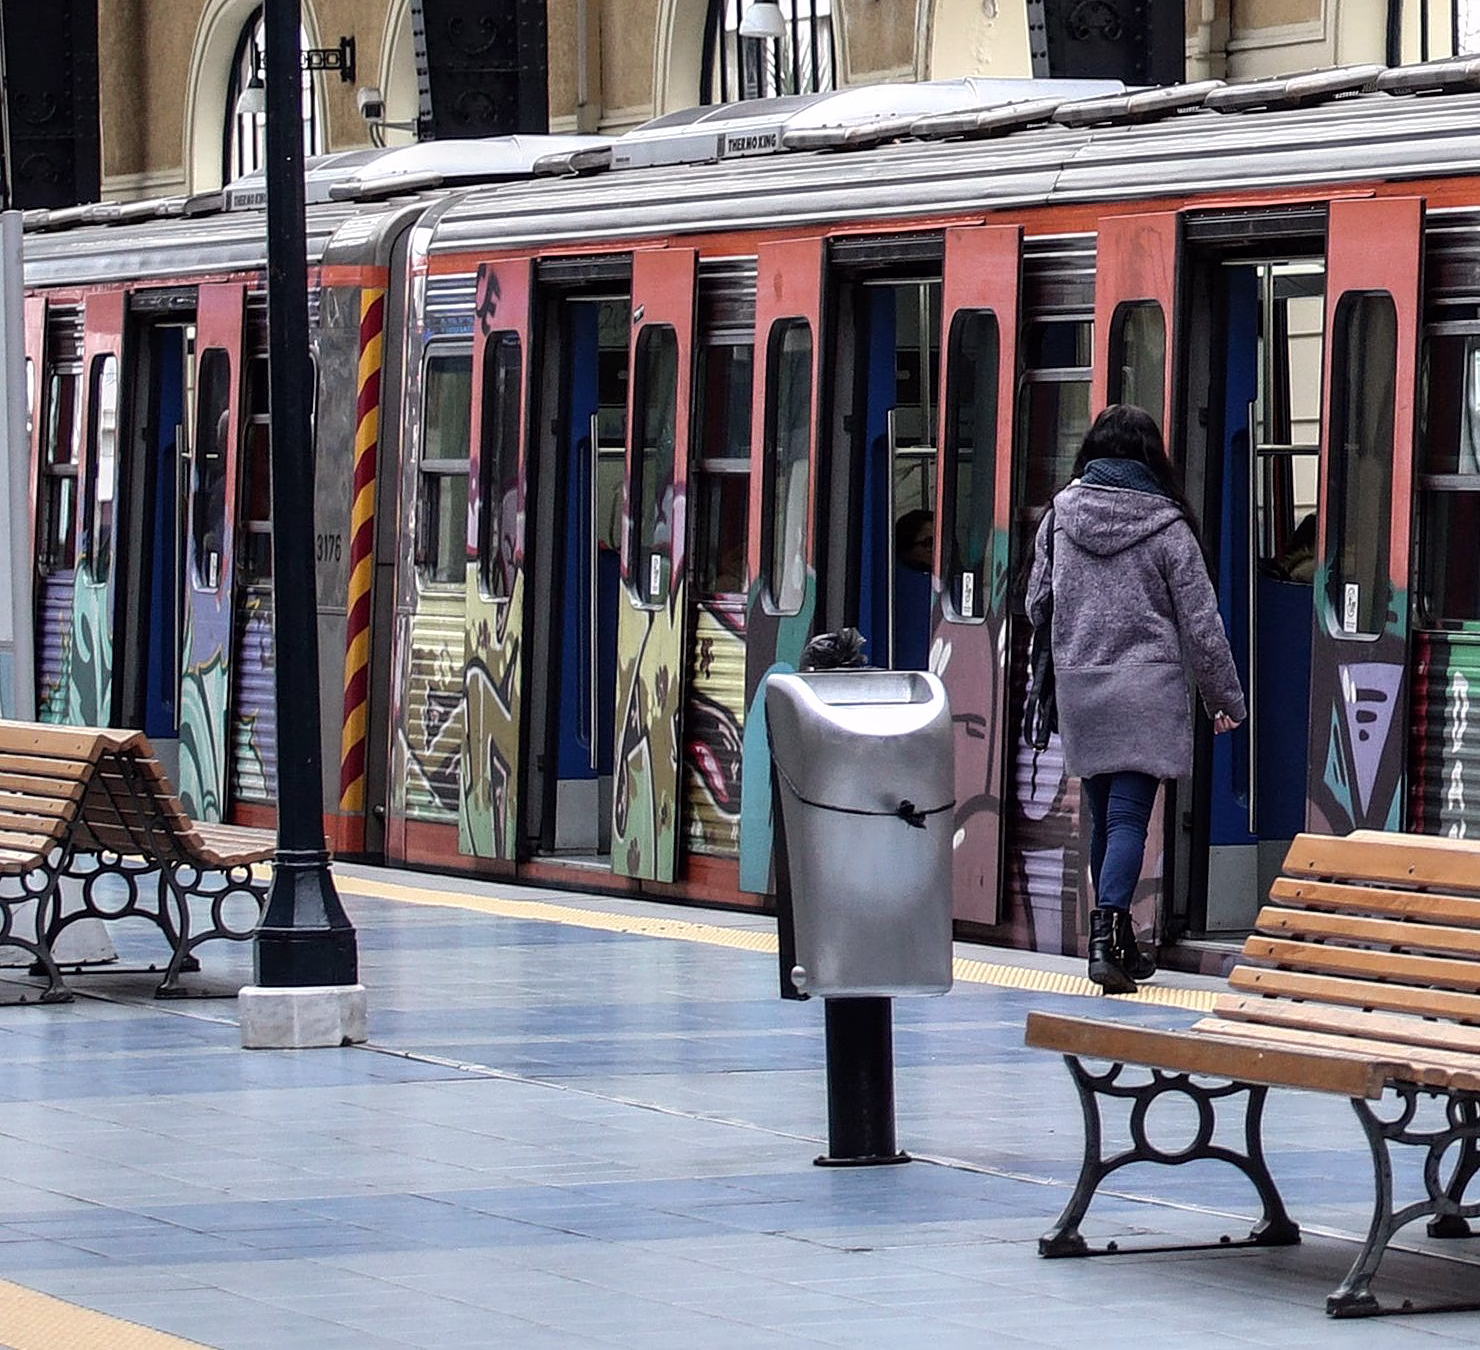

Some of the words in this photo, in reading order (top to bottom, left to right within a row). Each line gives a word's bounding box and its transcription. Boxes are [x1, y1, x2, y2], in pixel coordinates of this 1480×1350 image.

[729, 136, 757, 152] THERMO
[758, 134, 777, 149] KING
[317, 534, 342, 562] 3176
